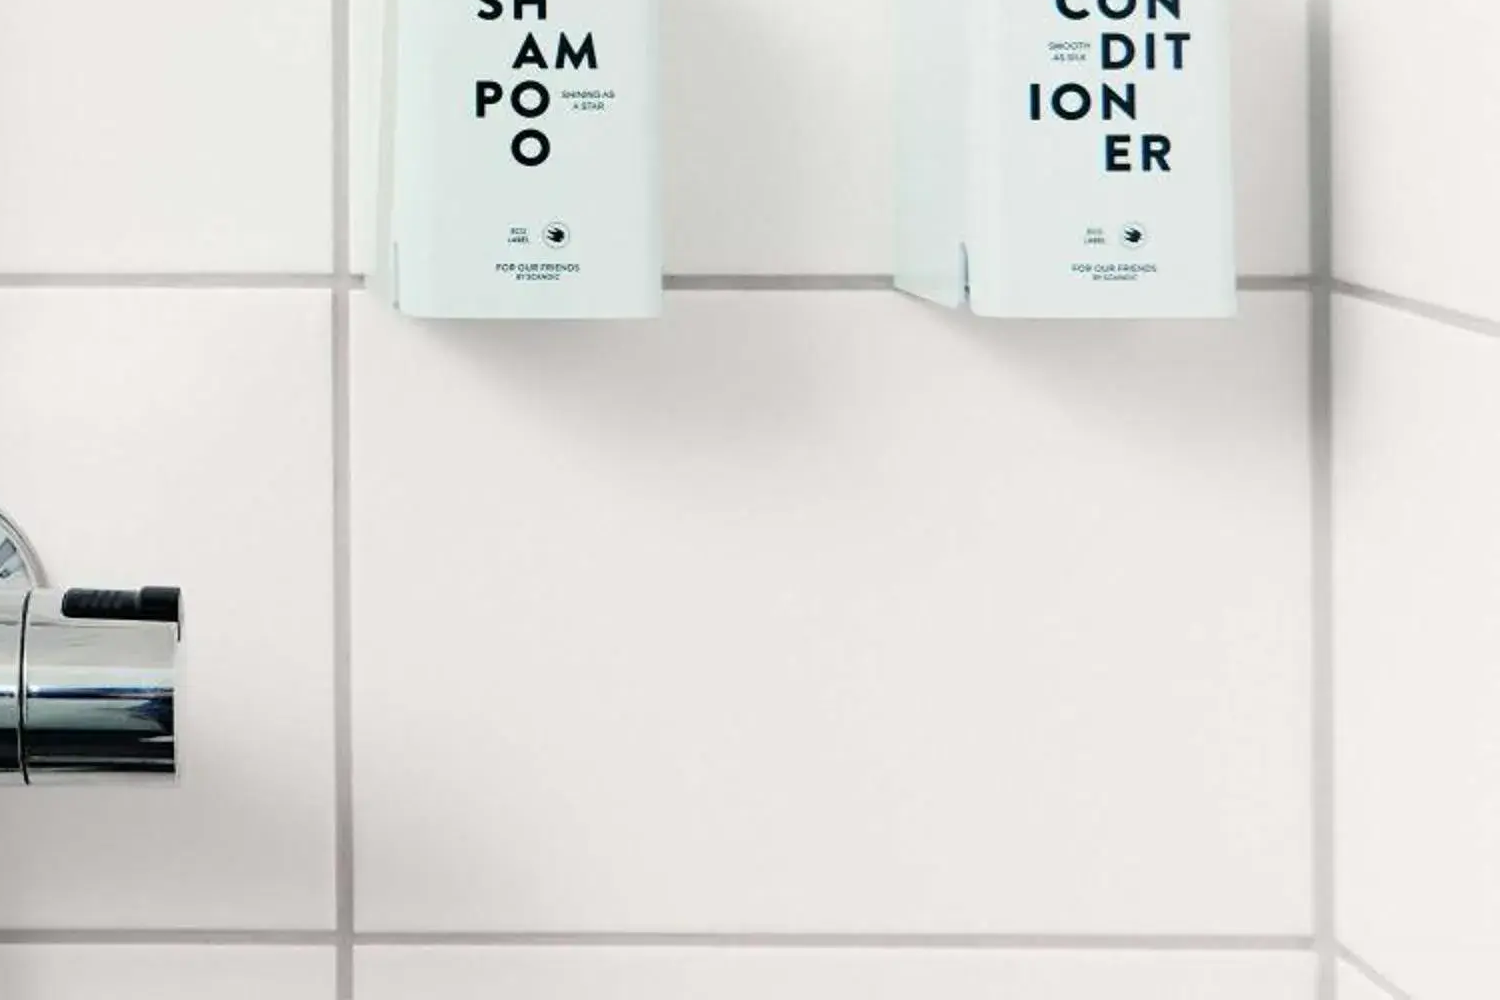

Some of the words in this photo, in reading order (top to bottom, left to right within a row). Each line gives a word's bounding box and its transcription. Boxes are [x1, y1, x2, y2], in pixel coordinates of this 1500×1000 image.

[512, 31, 598, 69] AM
[1101, 32, 1191, 70] DIT
[475, 80, 550, 119] PO
[581, 102, 605, 110] STAR
[1029, 83, 1136, 121] ION
[511, 128, 551, 167] O
[1105, 134, 1171, 172] ER
[496, 264, 516, 272] FOR
[518, 264, 539, 272] OUR
[540, 264, 580, 272] FRIENDS
